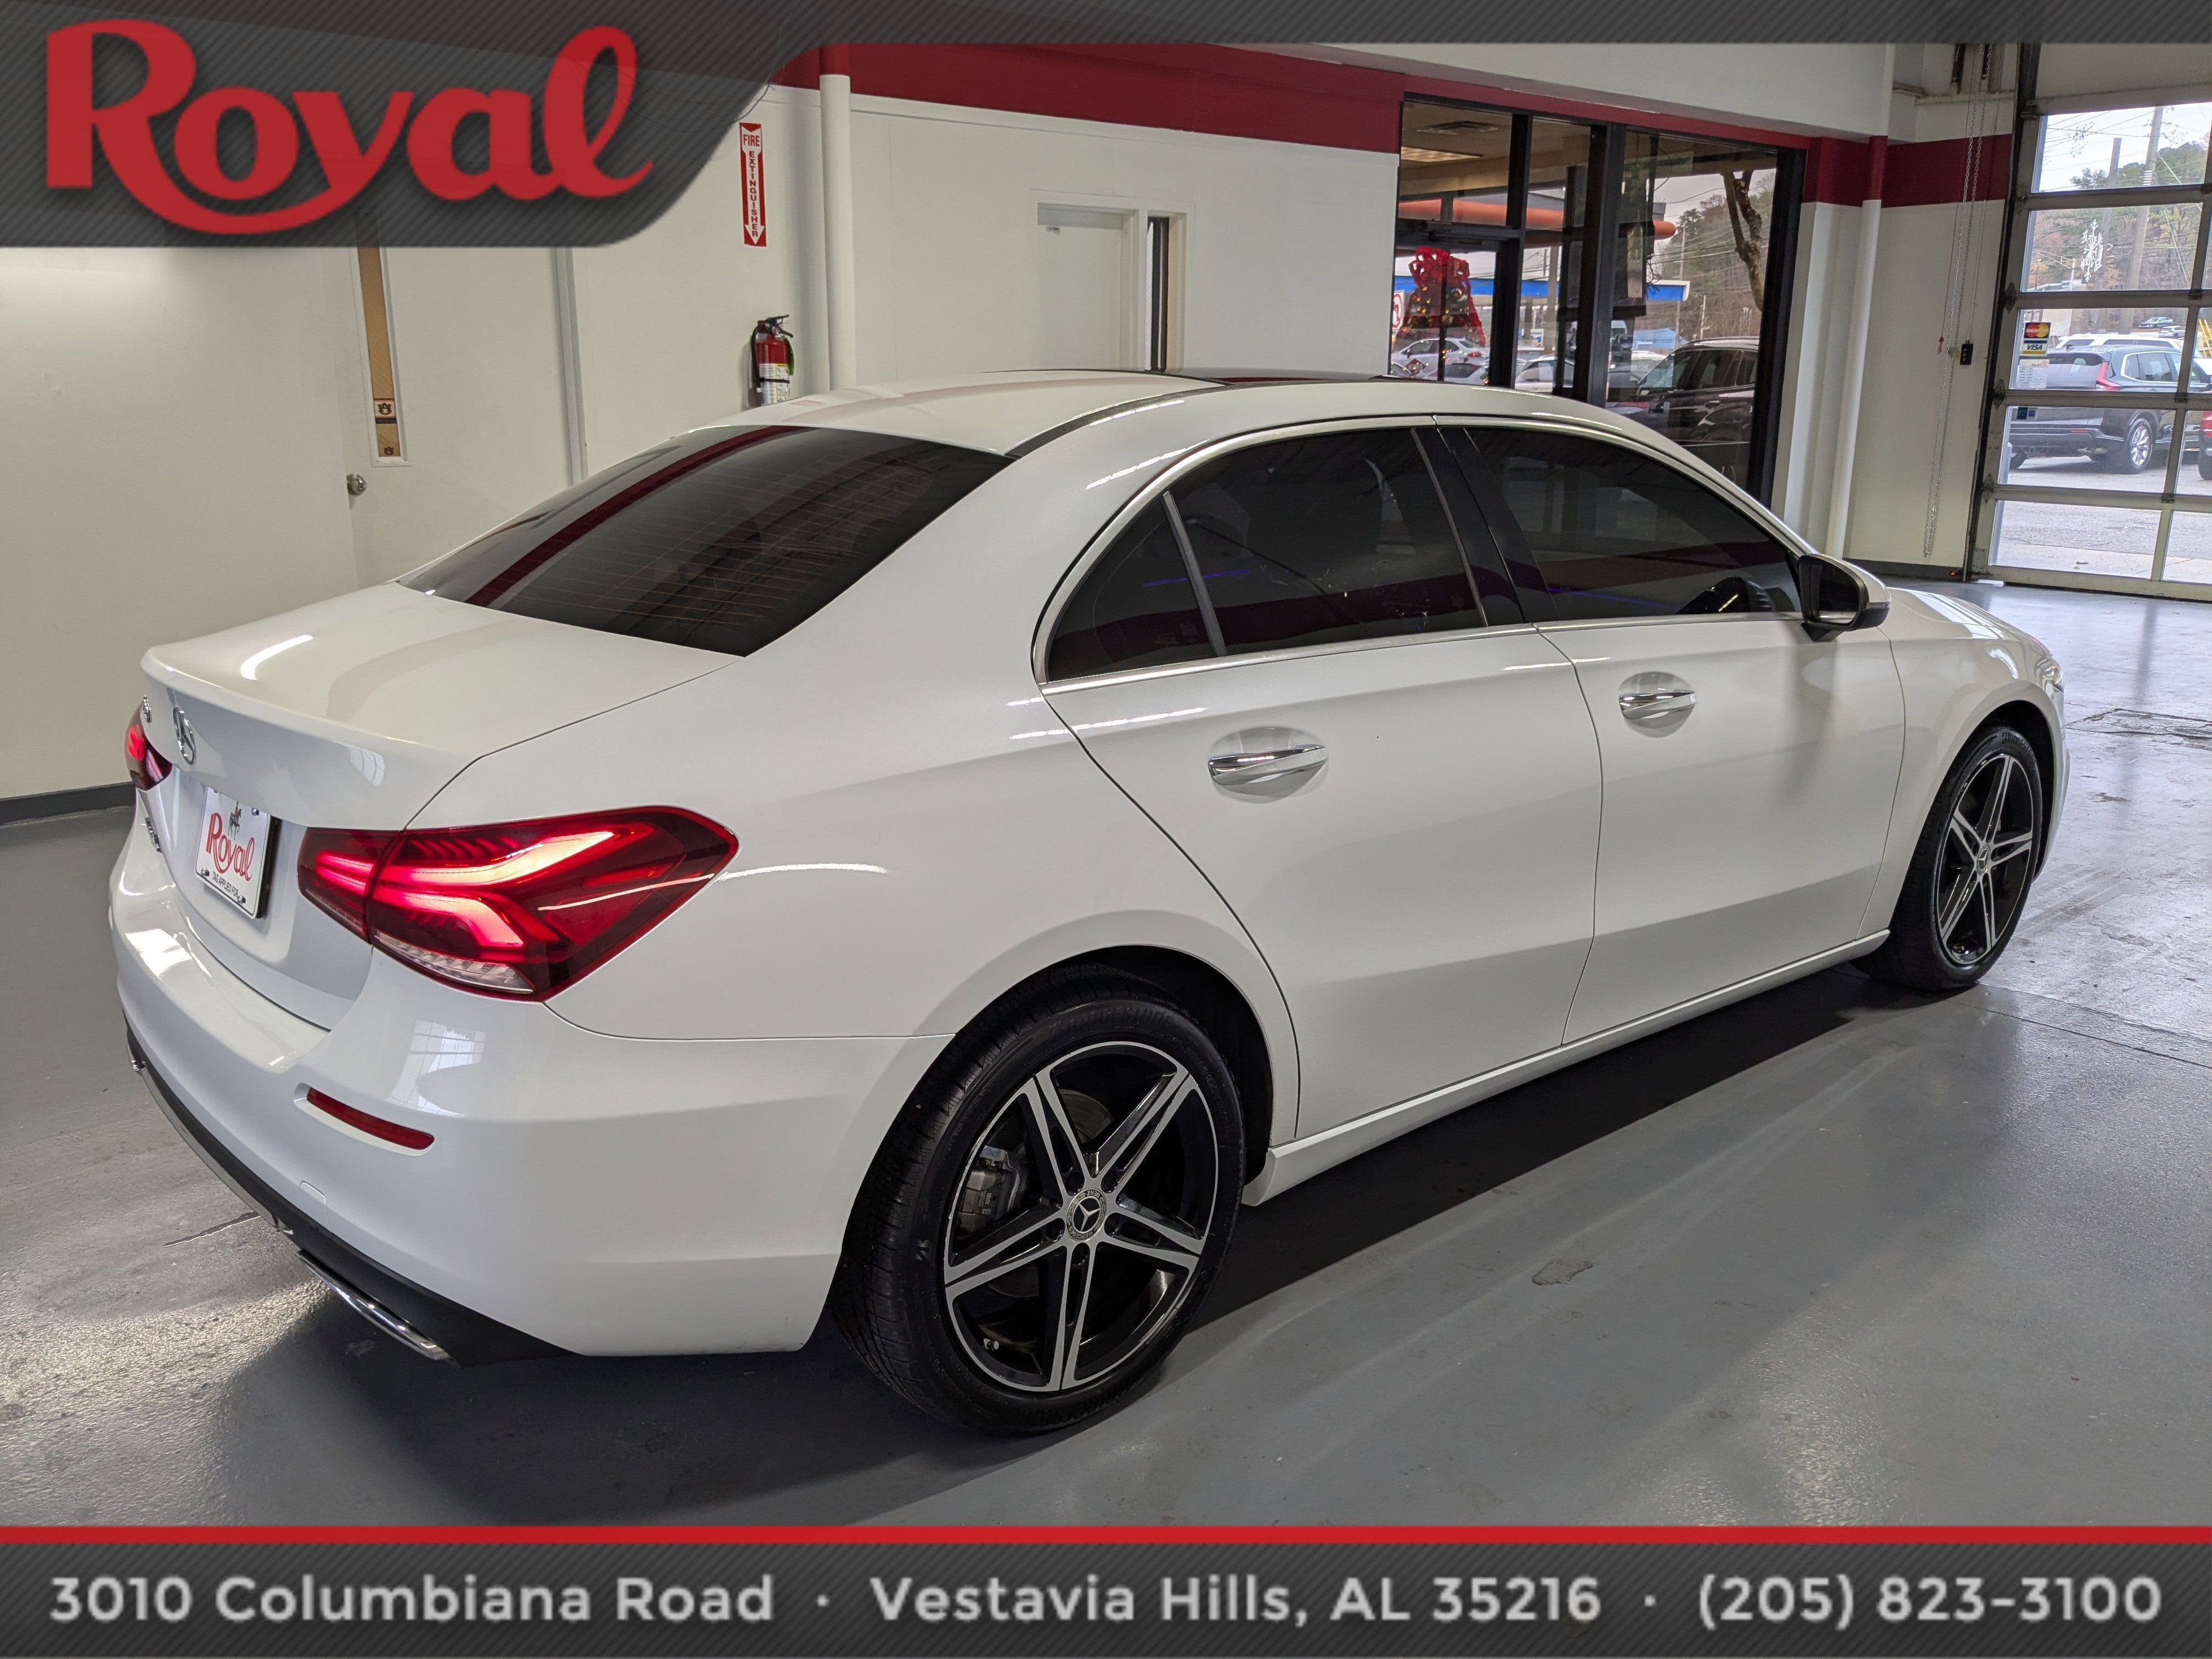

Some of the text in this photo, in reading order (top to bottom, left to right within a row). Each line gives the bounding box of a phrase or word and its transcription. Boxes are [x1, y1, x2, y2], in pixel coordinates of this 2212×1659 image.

[743, 134, 760, 147] FIRE
[748, 150, 759, 238] EXTINGUISHER
[205, 812, 255, 882] Royal
[219, 877, 232, 893] APPLIED
[1086, 1189, 1101, 1198] BENZ
[1068, 1225, 1093, 1240] MERCEDES
